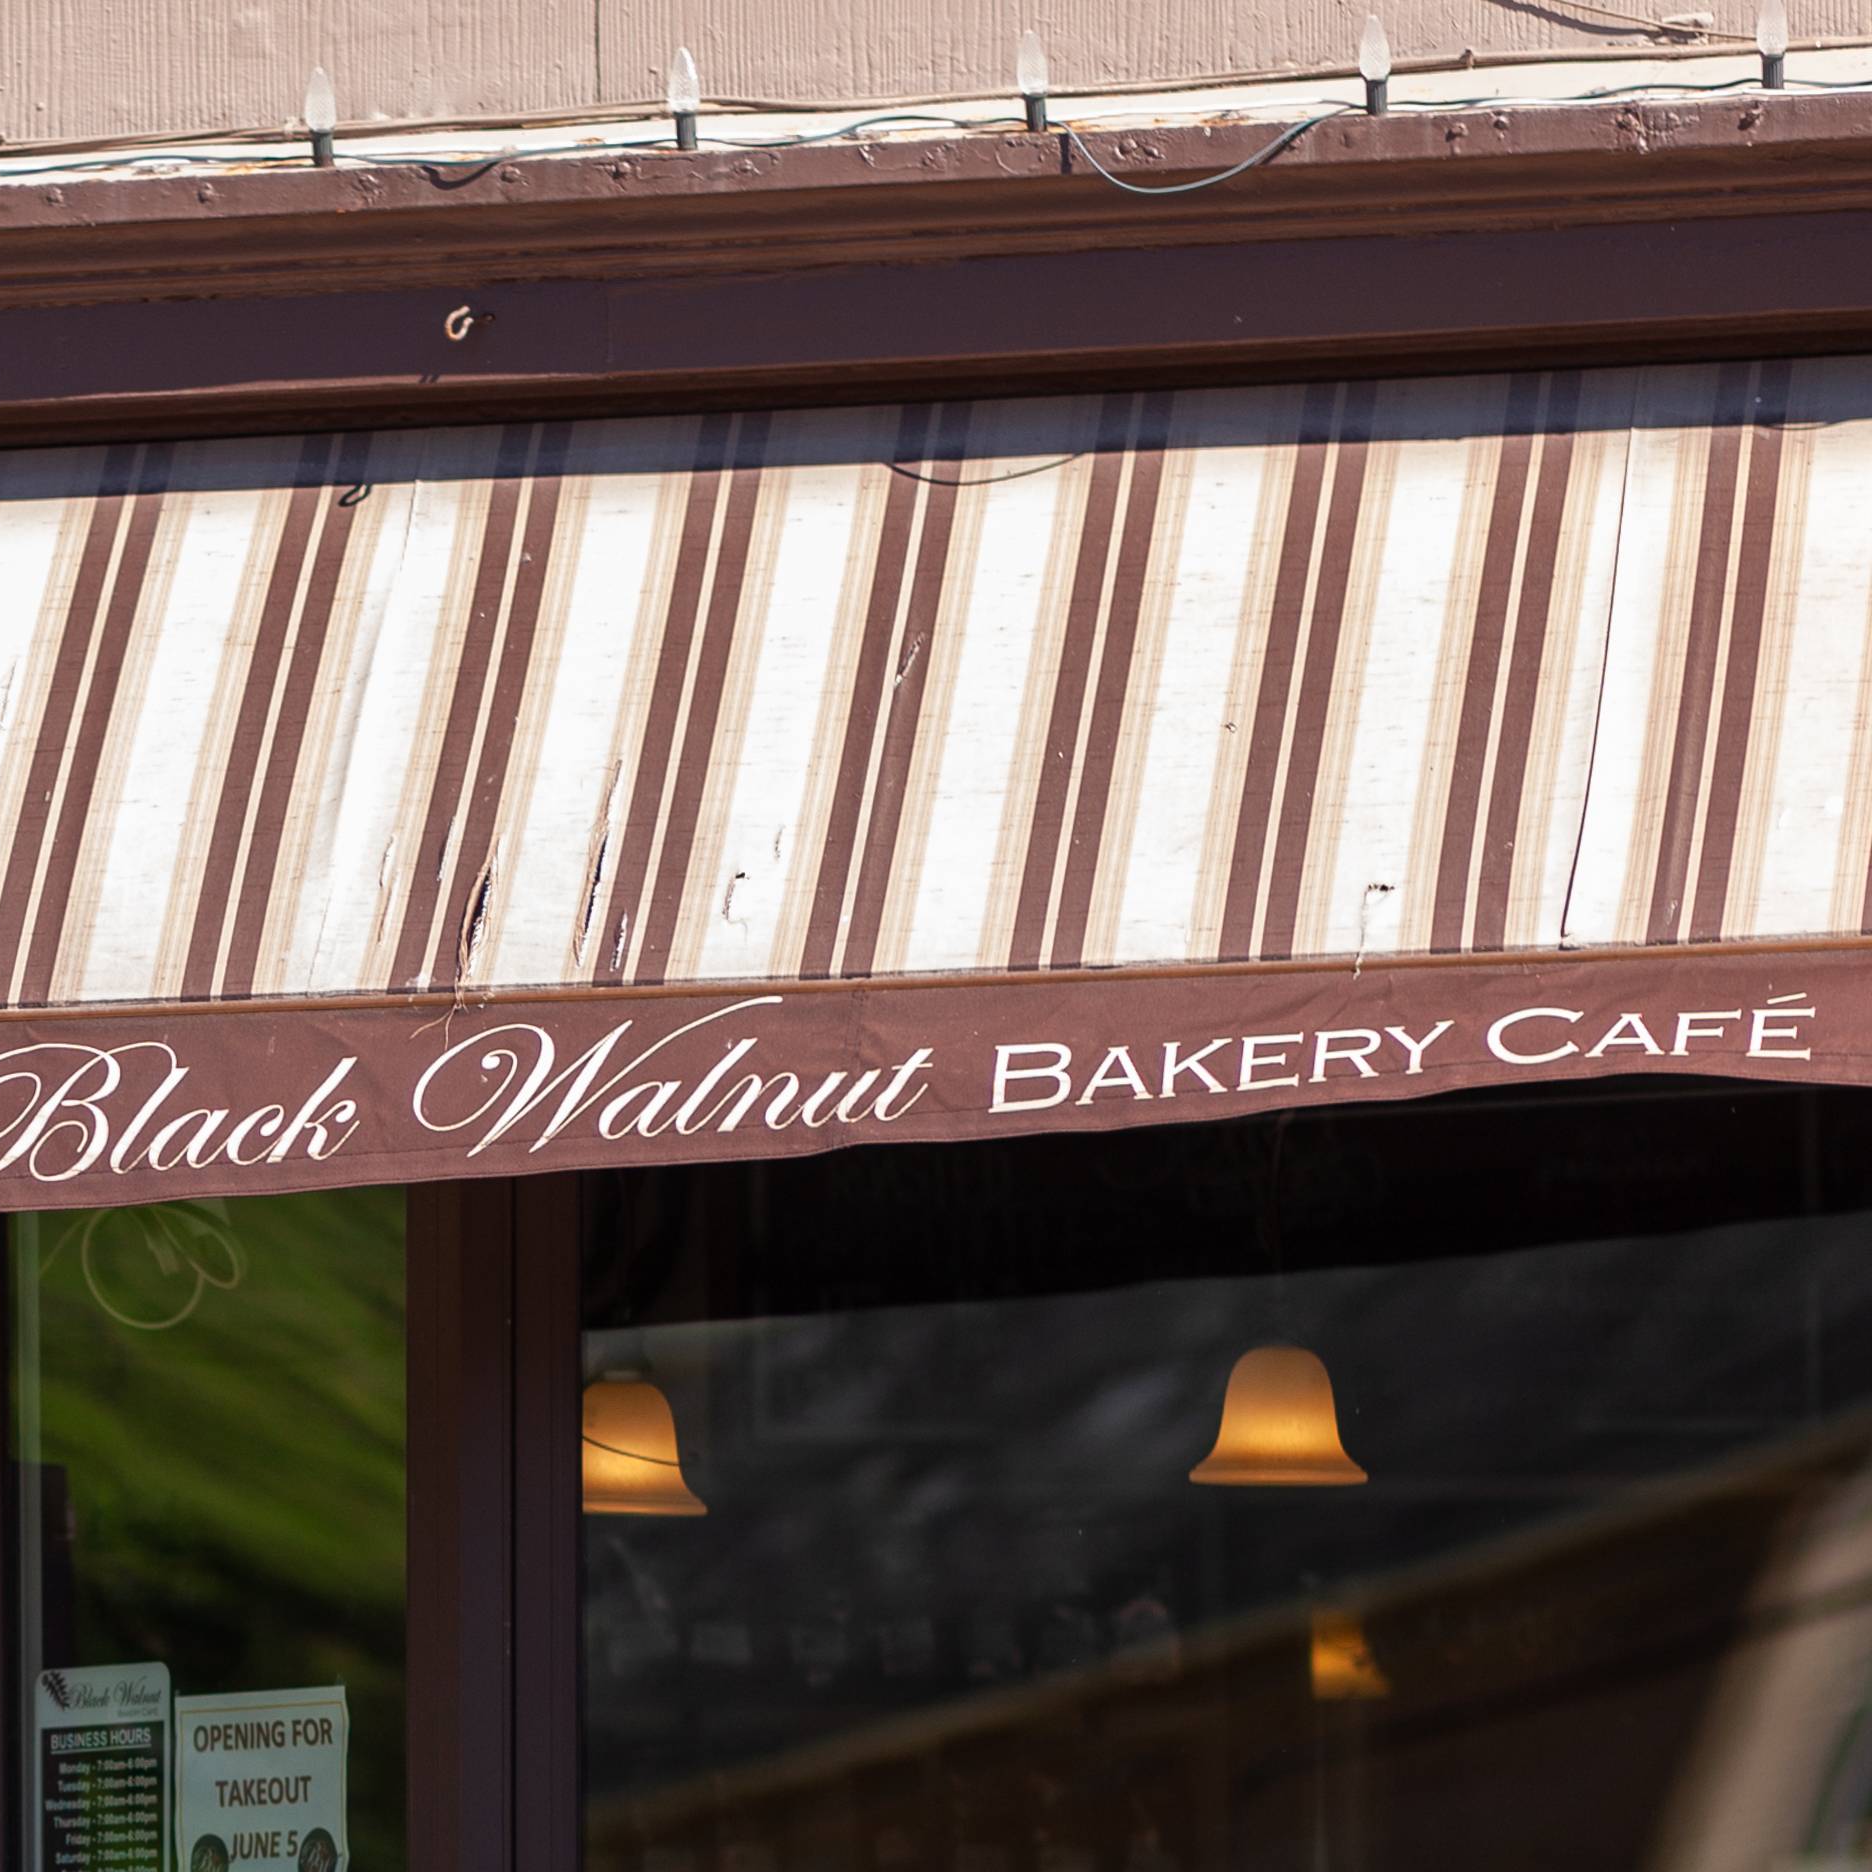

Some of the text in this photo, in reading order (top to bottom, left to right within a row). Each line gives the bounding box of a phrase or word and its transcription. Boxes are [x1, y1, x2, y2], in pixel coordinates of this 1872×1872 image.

[413, 996, 935, 1157] Walnut
[987, 1020, 1454, 1114] BAKERY
[1486, 993, 1816, 1064] CAFÉ
[50, 1727, 152, 1750] BUSINESS HOURS
[193, 1718, 333, 1752] OPENING FOR
[215, 1775, 312, 1808] TAKEOUT
[229, 1831, 281, 1862] JUNE
[286, 1830, 298, 1857] 5
